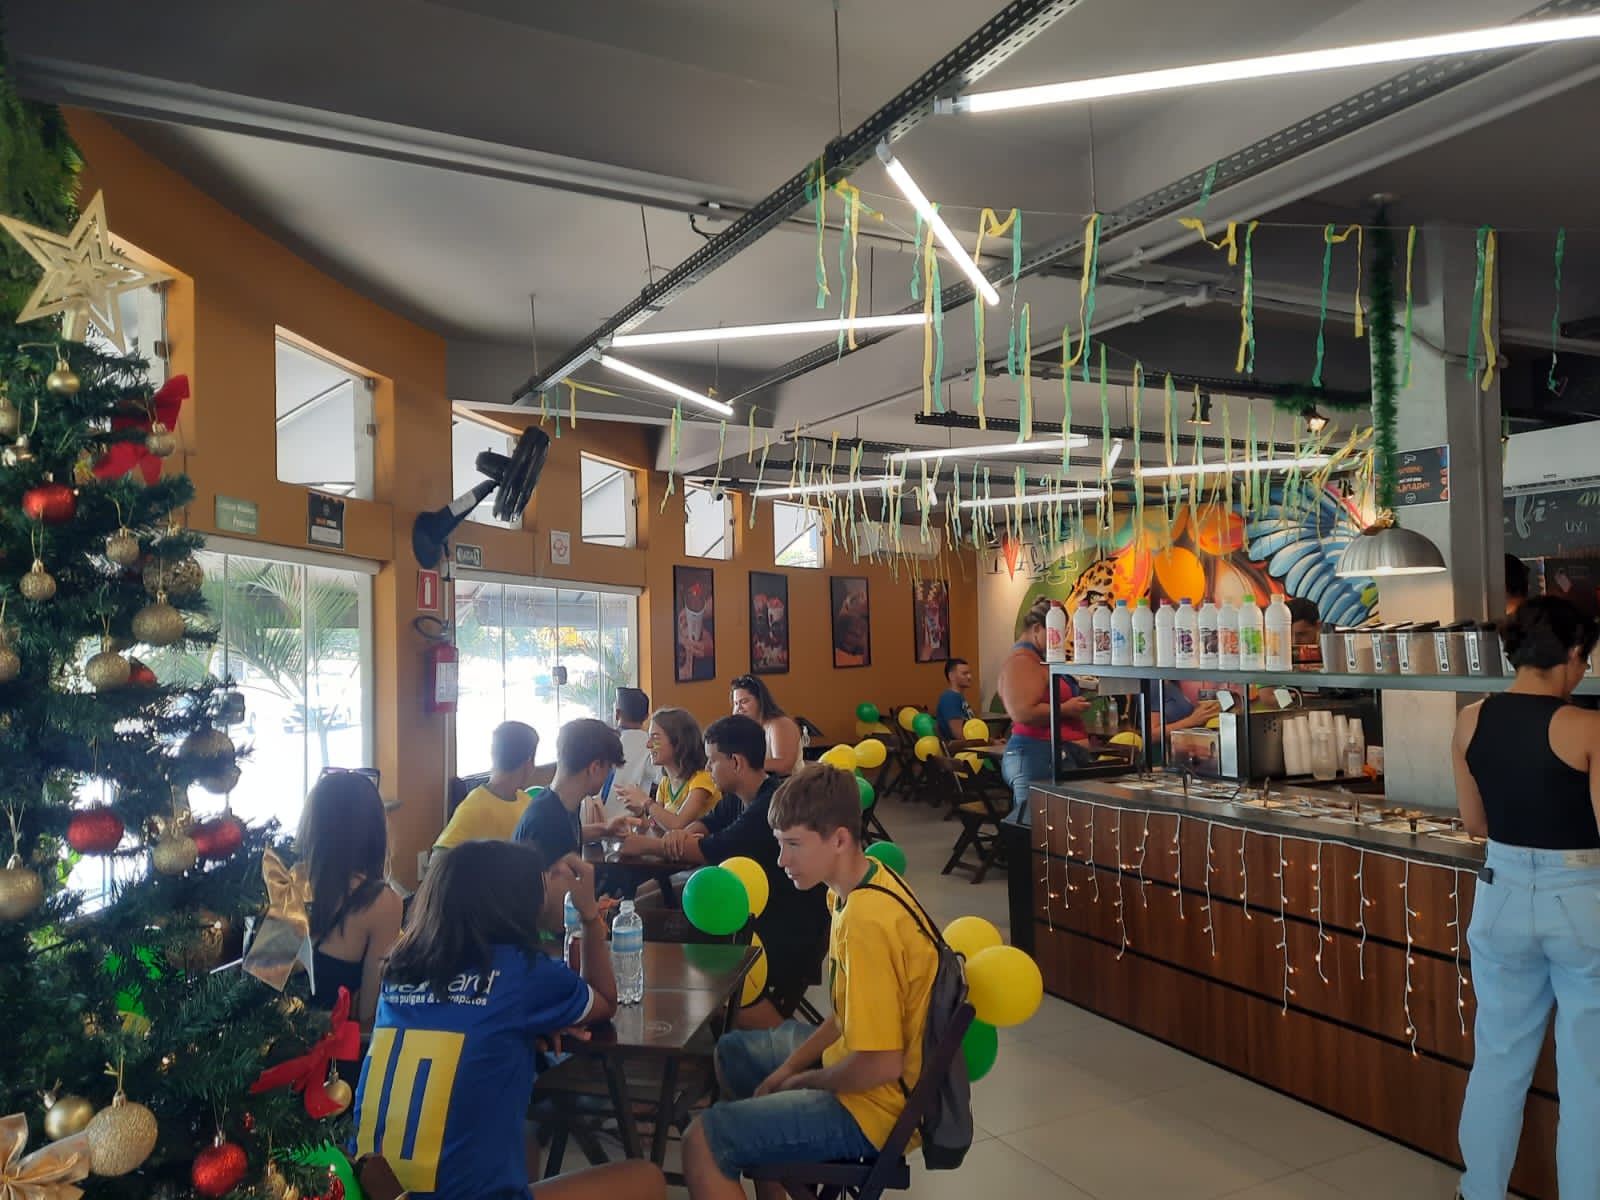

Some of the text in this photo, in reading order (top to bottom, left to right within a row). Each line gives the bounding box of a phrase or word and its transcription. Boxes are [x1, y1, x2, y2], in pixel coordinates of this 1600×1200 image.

[399, 993, 426, 1006] pulgas
[427, 993, 435, 1004] &
[356, 1027, 466, 1193] 10
